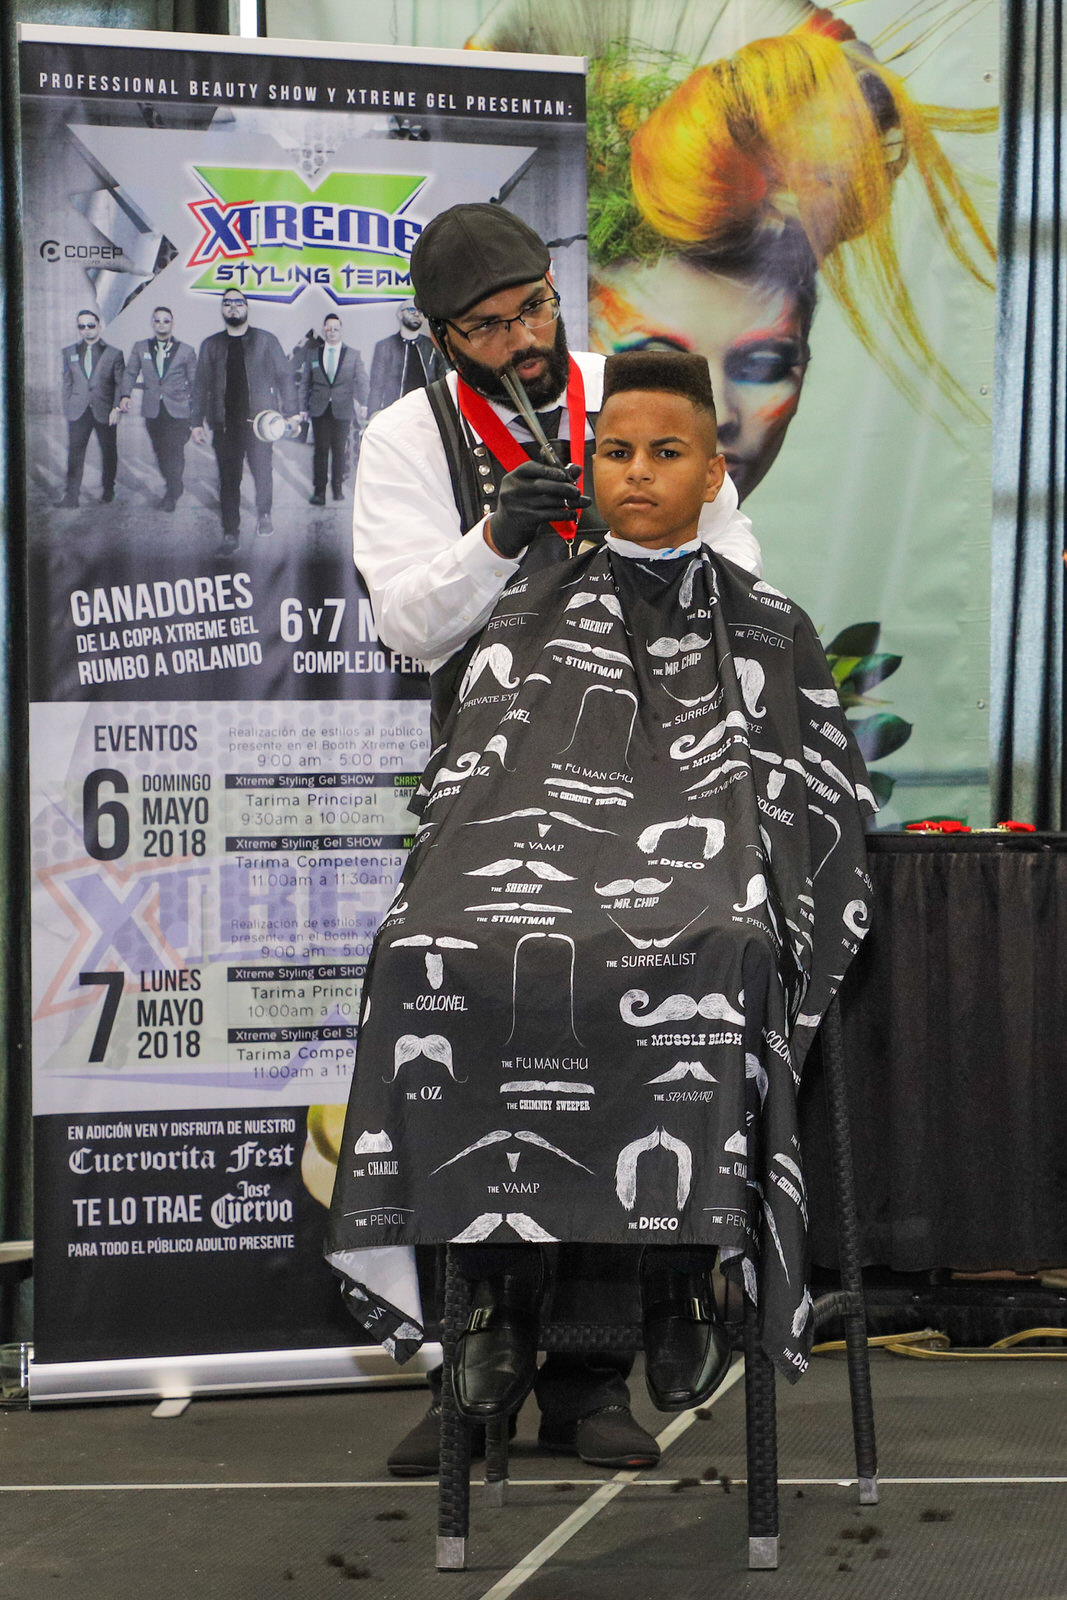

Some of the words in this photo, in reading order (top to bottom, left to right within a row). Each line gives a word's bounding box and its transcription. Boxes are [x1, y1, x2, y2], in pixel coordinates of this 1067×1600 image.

[40, 73, 178, 95] PROFESSIONAL
[189, 81, 258, 99] BEAUTY
[269, 84, 317, 101] SHOW
[327, 88, 336, 102] Y
[347, 89, 416, 107] XTREME
[427, 93, 456, 109] GEL
[467, 96, 573, 116] PRESENTAN:
[216, 261, 330, 286] STYLING
[340, 264, 411, 288] TEAM
[70, 572, 254, 627] GANADORES
[761, 597, 791, 614] CHARLIE
[488, 617, 526, 631] PENCIL
[579, 618, 613, 634] SHERIFF
[76, 634, 96, 653] DE
[101, 631, 120, 651] LA
[122, 627, 162, 649] COPA
[167, 621, 228, 644] XTREME
[231, 616, 259, 636] GEL
[735, 630, 745, 638] THE
[747, 630, 786, 649] PENCIL
[78, 654, 149, 685] RUMBO
[155, 652, 168, 677] A
[172, 642, 262, 674] ORLANDO
[293, 651, 385, 674] COMPLEJO
[552, 655, 563, 664] THE
[565, 656, 623, 680] STUNTMAN
[653, 668, 664, 676] THE
[665, 661, 680, 676] MR.
[681, 652, 701, 671] CHIP
[464, 695, 499, 709] PRIVATE
[94, 725, 198, 752] EVENTOS
[302, 728, 316, 736] de
[321, 727, 359, 736] estilos
[229, 742, 282, 752] presente
[287, 742, 301, 750] en
[306, 740, 317, 749] el
[323, 740, 356, 750] Booth
[362, 740, 404, 750] Xtreme
[409, 740, 429, 749] Gel
[258, 754, 291, 767] 9:00
[299, 755, 321, 766] am
[340, 754, 372, 766] 5:00
[380, 755, 403, 768] pm
[552, 763, 562, 771] THE
[582, 769, 606, 780] MAN
[609, 772, 633, 784] CHU
[142, 774, 211, 791] DOMINGO
[236, 776, 274, 785] Xtreme
[279, 776, 314, 788] Styling
[319, 775, 336, 785] Gel
[341, 775, 375, 785] SHOW
[246, 794, 300, 807] Tarima
[308, 793, 377, 808] Principal
[560, 791, 593, 805] CHIMNEY
[595, 797, 627, 807] SWEEPER
[83, 769, 129, 861] 6
[142, 797, 210, 825] MAYO
[241, 813, 298, 825] 9:30am
[305, 815, 312, 824] a
[320, 812, 384, 824] 10:00am
[143, 829, 206, 858] 2018
[236, 838, 277, 849] Xtreme
[282, 838, 319, 851] Styling
[324, 838, 342, 848] Gel
[347, 837, 382, 847] SHOW
[528, 841, 564, 852] VAMP
[235, 856, 289, 869] Tarima
[297, 855, 402, 868] Competencia
[660, 858, 705, 869] DISCO
[505, 882, 543, 894] SHERIFF
[613, 898, 632, 909] MR.
[633, 896, 659, 908] CHIP
[304, 919, 318, 928] de
[324, 918, 362, 928] estilos
[491, 915, 555, 925] STUNTMAN
[232, 934, 285, 944] presente
[324, 931, 359, 941] Booth
[303, 947, 325, 957] am
[606, 960, 617, 968] THE
[621, 953, 696, 968] SURREALIST
[140, 969, 201, 992] LUNES
[235, 969, 274, 979] Xtreme
[279, 968, 314, 980] Styling
[318, 967, 335, 977] Gel
[251, 986, 305, 999] Tarima
[403, 1002, 414, 1010] THE
[416, 995, 468, 1012] COLONEL
[79, 971, 124, 1063] 7
[137, 998, 204, 1028] MAYO
[236, 1031, 276, 1041] Xtreme
[281, 1030, 318, 1042] Styling
[323, 1029, 341, 1039] Gel
[636, 1038, 648, 1047] THE
[651, 1033, 706, 1047] MUSCLE
[708, 1032, 742, 1046] BEACH
[138, 1030, 201, 1060] 2018
[237, 1048, 291, 1061] Tarima
[502, 1060, 512, 1068] THE
[516, 1058, 531, 1069] FU
[534, 1058, 559, 1070] MAN
[562, 1058, 589, 1070] CHU
[407, 1092, 417, 1100] THE
[420, 1086, 442, 1100] OZ
[666, 1090, 714, 1102] SPANIARD
[507, 1102, 518, 1110] THE
[519, 1100, 552, 1111] CHIMNEY
[556, 1100, 590, 1111] SWEEPER
[68, 1126, 83, 1140] EN
[86, 1122, 132, 1139] ADICIÓN
[135, 1124, 157, 1138] VEN
[160, 1123, 168, 1136] Y
[171, 1121, 225, 1136] DISFRUTA
[227, 1121, 242, 1135] DE
[245, 1119, 295, 1134] NUESTRO
[69, 1145, 215, 1174] Cuervorita
[226, 1141, 295, 1173] Fest
[353, 1169, 365, 1177] THE
[368, 1161, 398, 1176] CHARLIE
[719, 1166, 730, 1174] THE
[237, 1180, 271, 1200] Jose
[502, 1183, 540, 1194] VAMP
[73, 1199, 101, 1226] TE
[108, 1197, 136, 1225] LO
[143, 1195, 202, 1224] TRAE
[211, 1192, 293, 1230] Cuervo
[355, 1219, 367, 1227] THE
[370, 1214, 405, 1226] PENCIL
[628, 1222, 638, 1230] THE
[639, 1217, 678, 1231] DISCO
[68, 1243, 97, 1257] PARA
[100, 1241, 128, 1256] TODO
[132, 1240, 144, 1254] EL
[147, 1237, 193, 1254] PÚBLICO
[196, 1237, 237, 1252] ADULTO
[239, 1235, 294, 1250] PRESENTE
